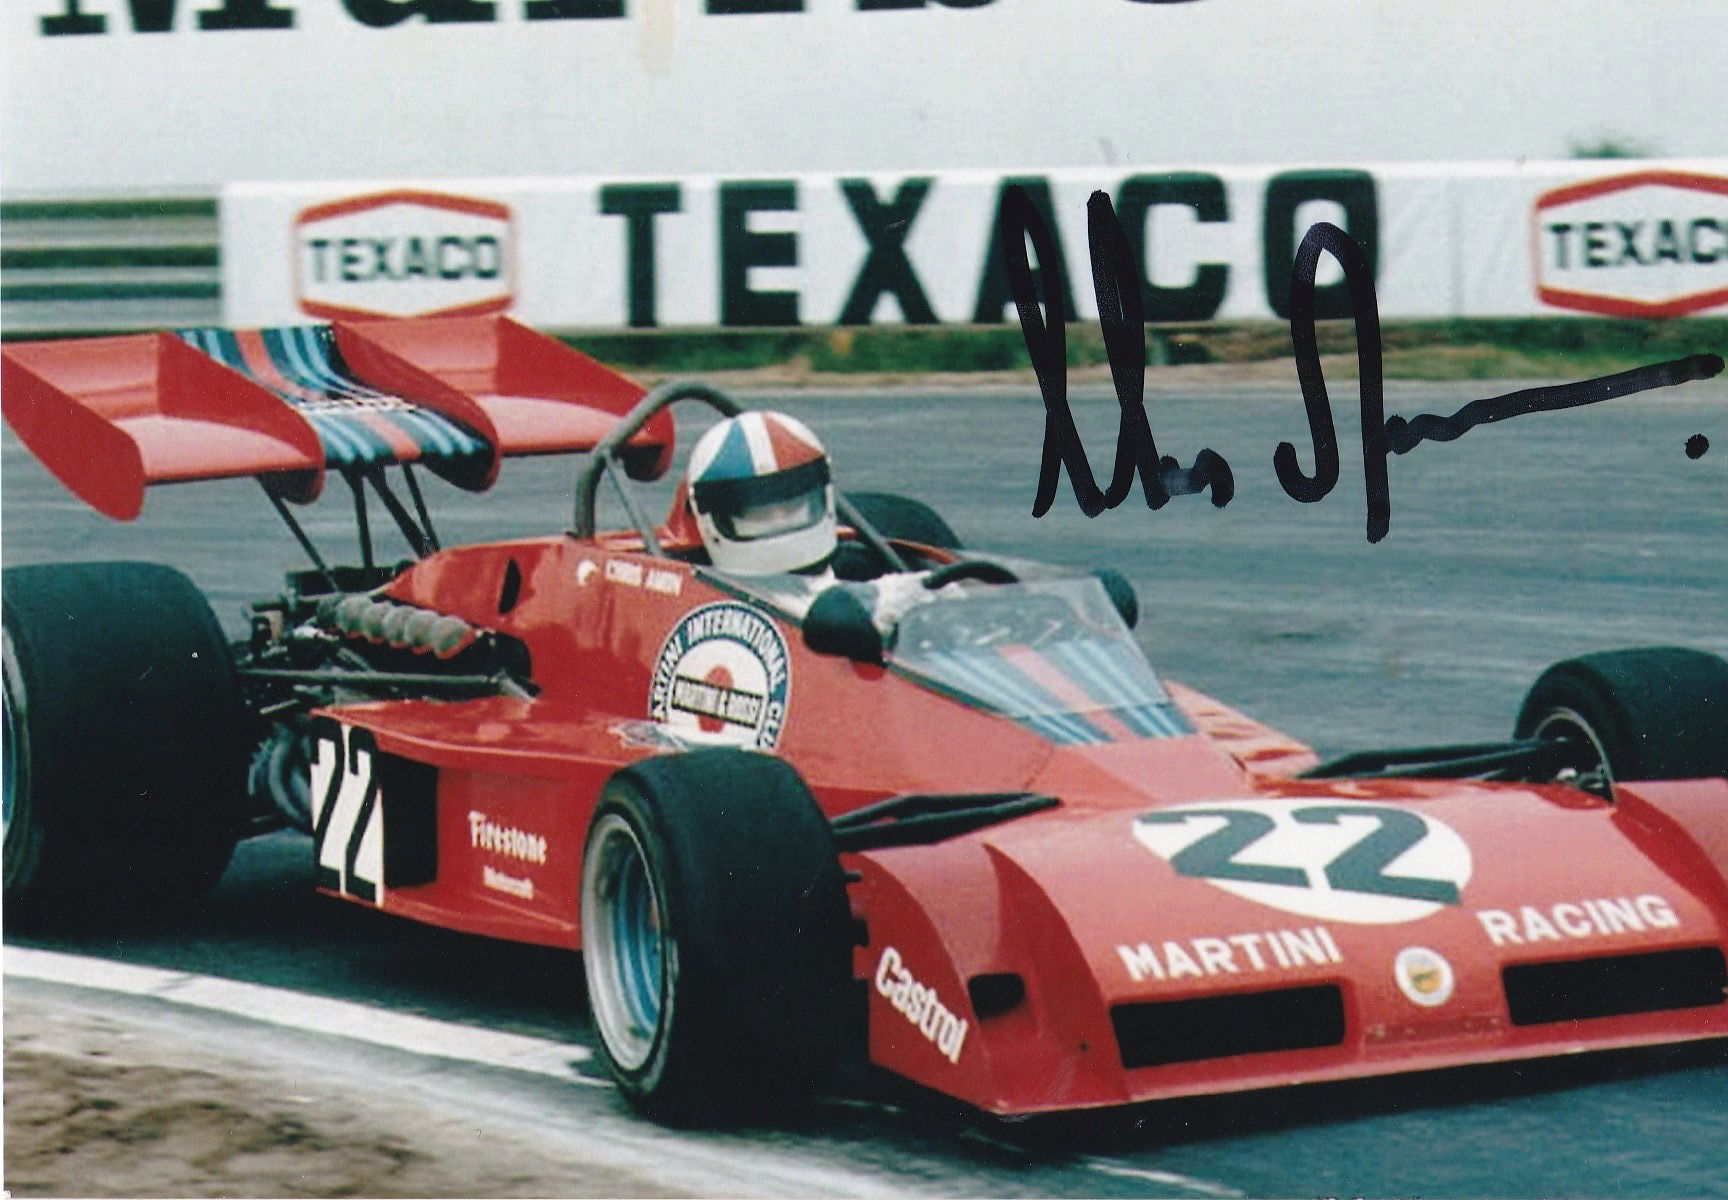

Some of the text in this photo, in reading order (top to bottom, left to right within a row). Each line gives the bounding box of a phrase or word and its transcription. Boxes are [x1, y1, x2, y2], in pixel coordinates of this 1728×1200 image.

[307, 234, 502, 284] TEXACO
[596, 171, 1381, 328] TEXACO
[686, 608, 787, 694] INTERNATIONAL
[468, 810, 548, 866] Firestone
[1139, 805, 1463, 907] 22
[1117, 894, 1682, 984] MARTINI RACING
[875, 946, 969, 1065] Castrol
